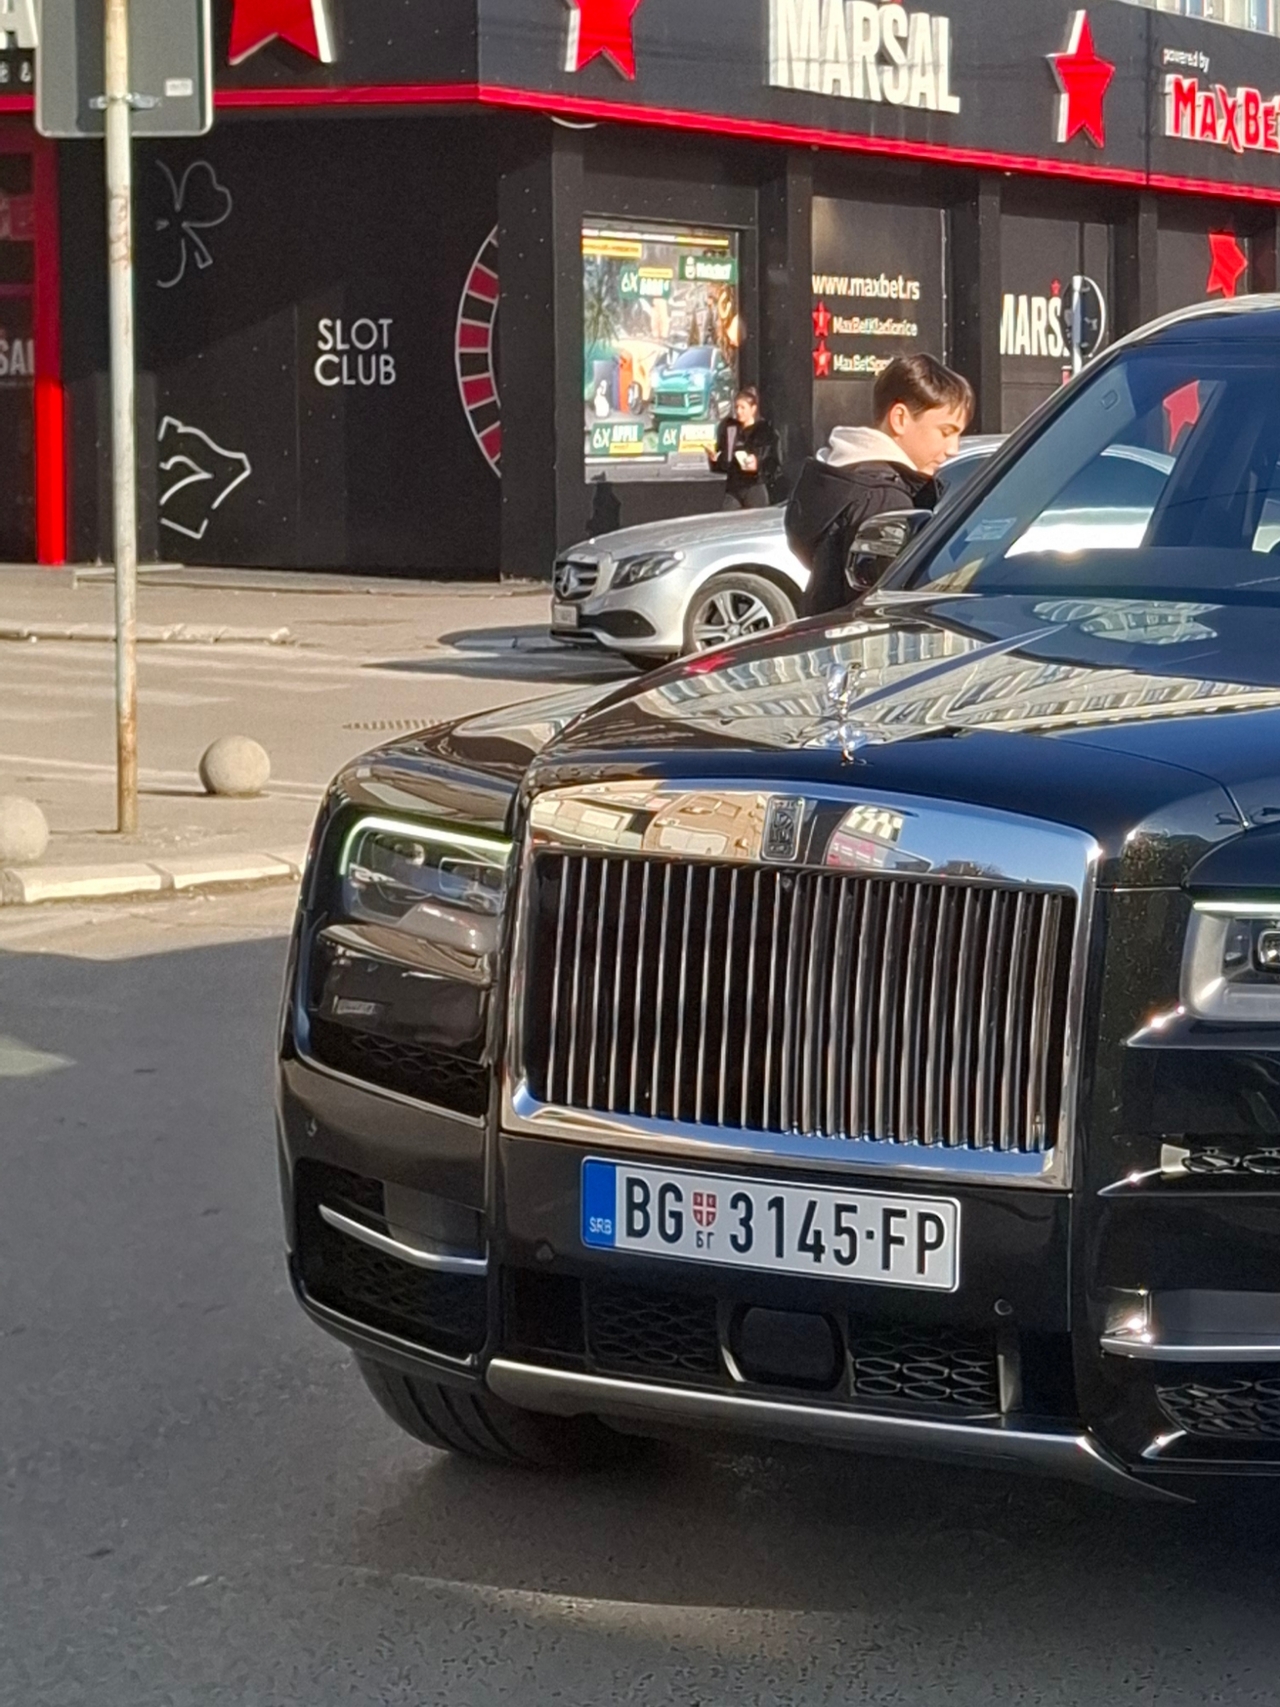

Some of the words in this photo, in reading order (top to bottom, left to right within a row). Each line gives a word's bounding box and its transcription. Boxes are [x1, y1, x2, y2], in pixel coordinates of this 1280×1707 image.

[1199, 51, 1211, 73] by
[812, 273, 920, 300] www.maxbet.rs
[317, 318, 393, 350] SLOT
[1000, 293, 1071, 358] MARS
[314, 353, 396, 386] CLUB
[589, 1216, 612, 1235] SRB
[626, 1176, 684, 1244] BG
